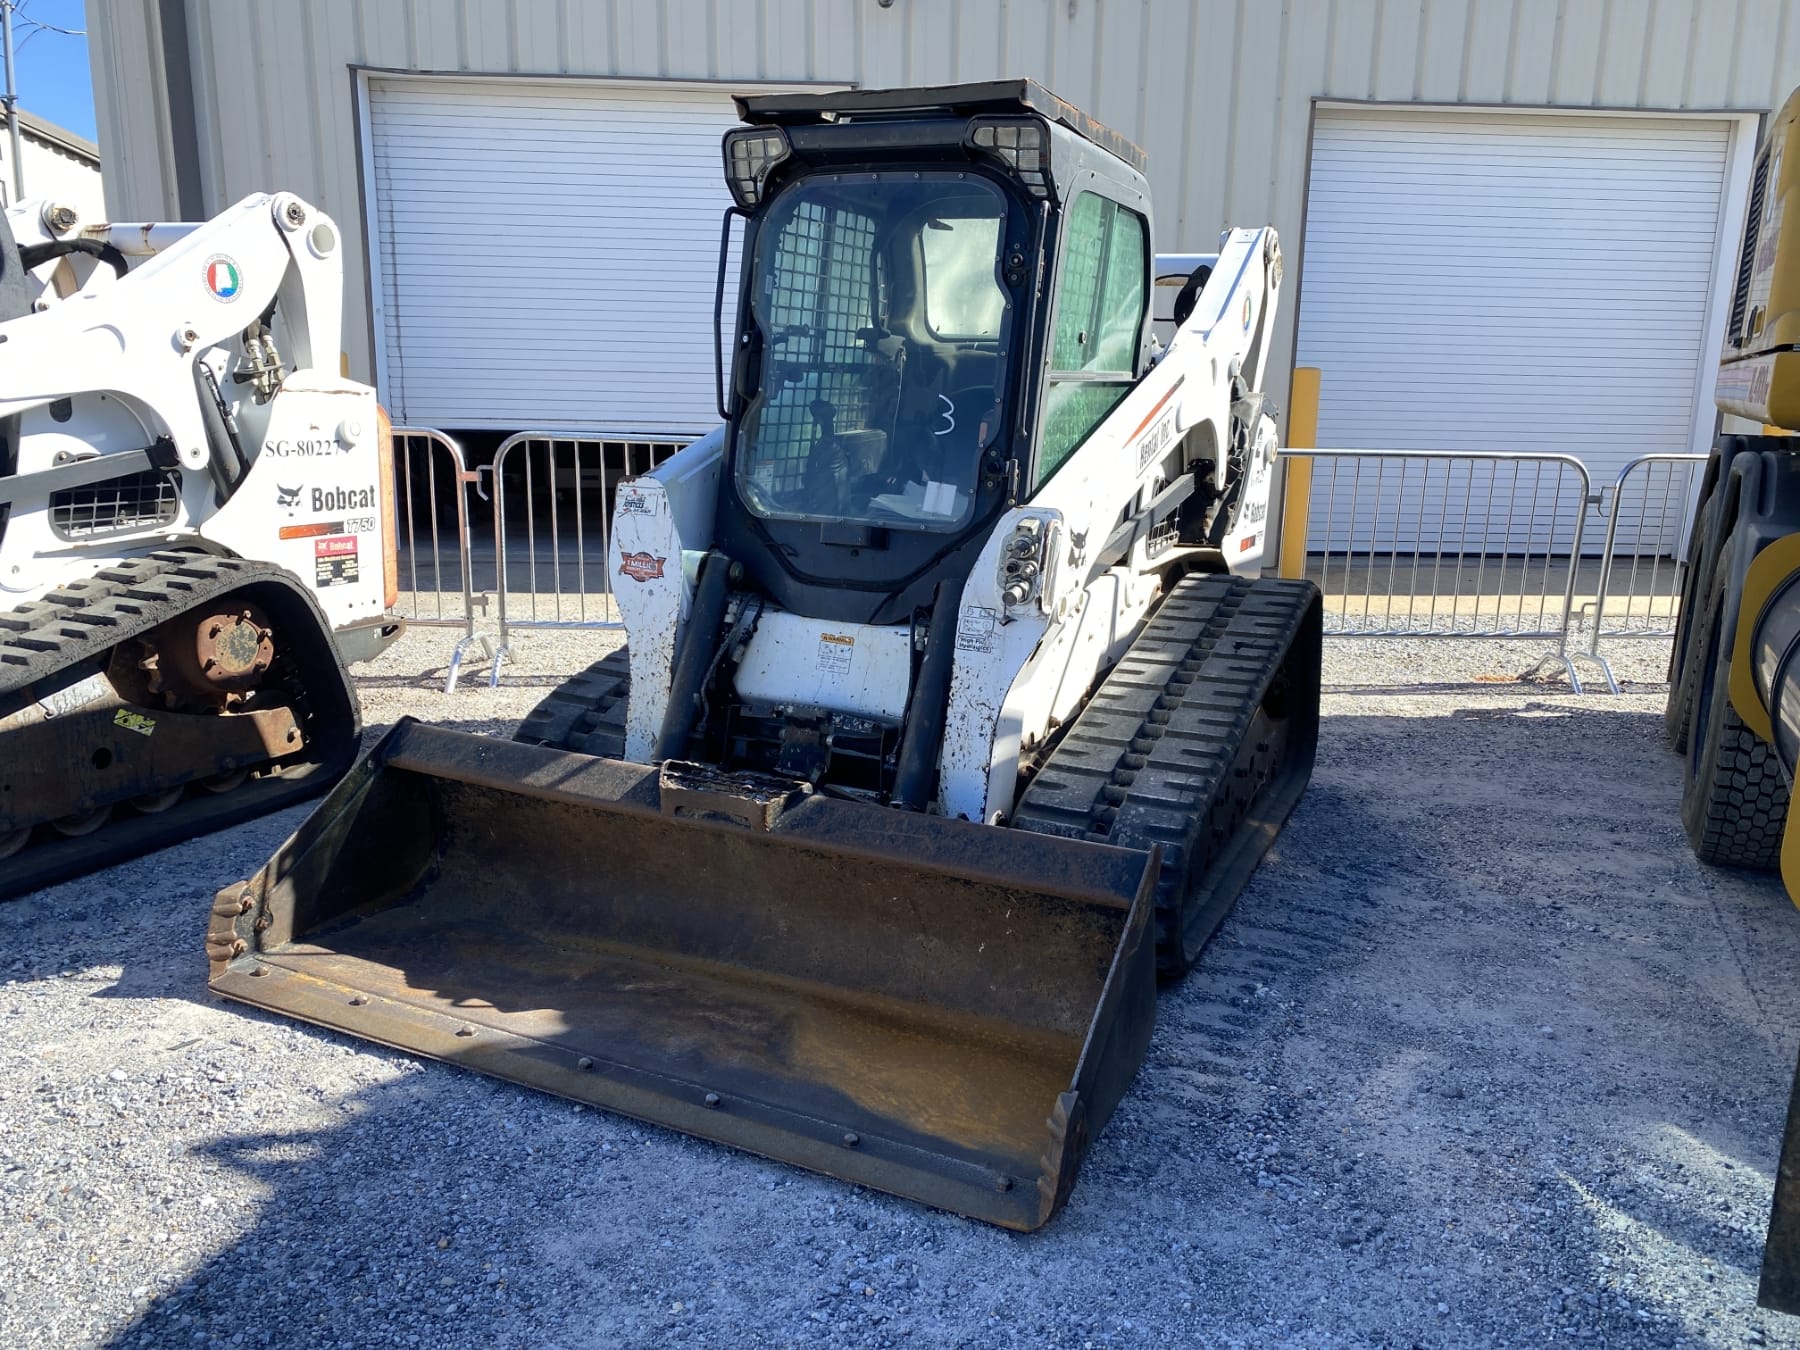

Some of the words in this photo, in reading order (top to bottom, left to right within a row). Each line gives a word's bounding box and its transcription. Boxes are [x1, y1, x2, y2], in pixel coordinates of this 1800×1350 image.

[934, 394, 955, 435] 3
[312, 484, 376, 513] Bobcat
[346, 517, 376, 534] T750
